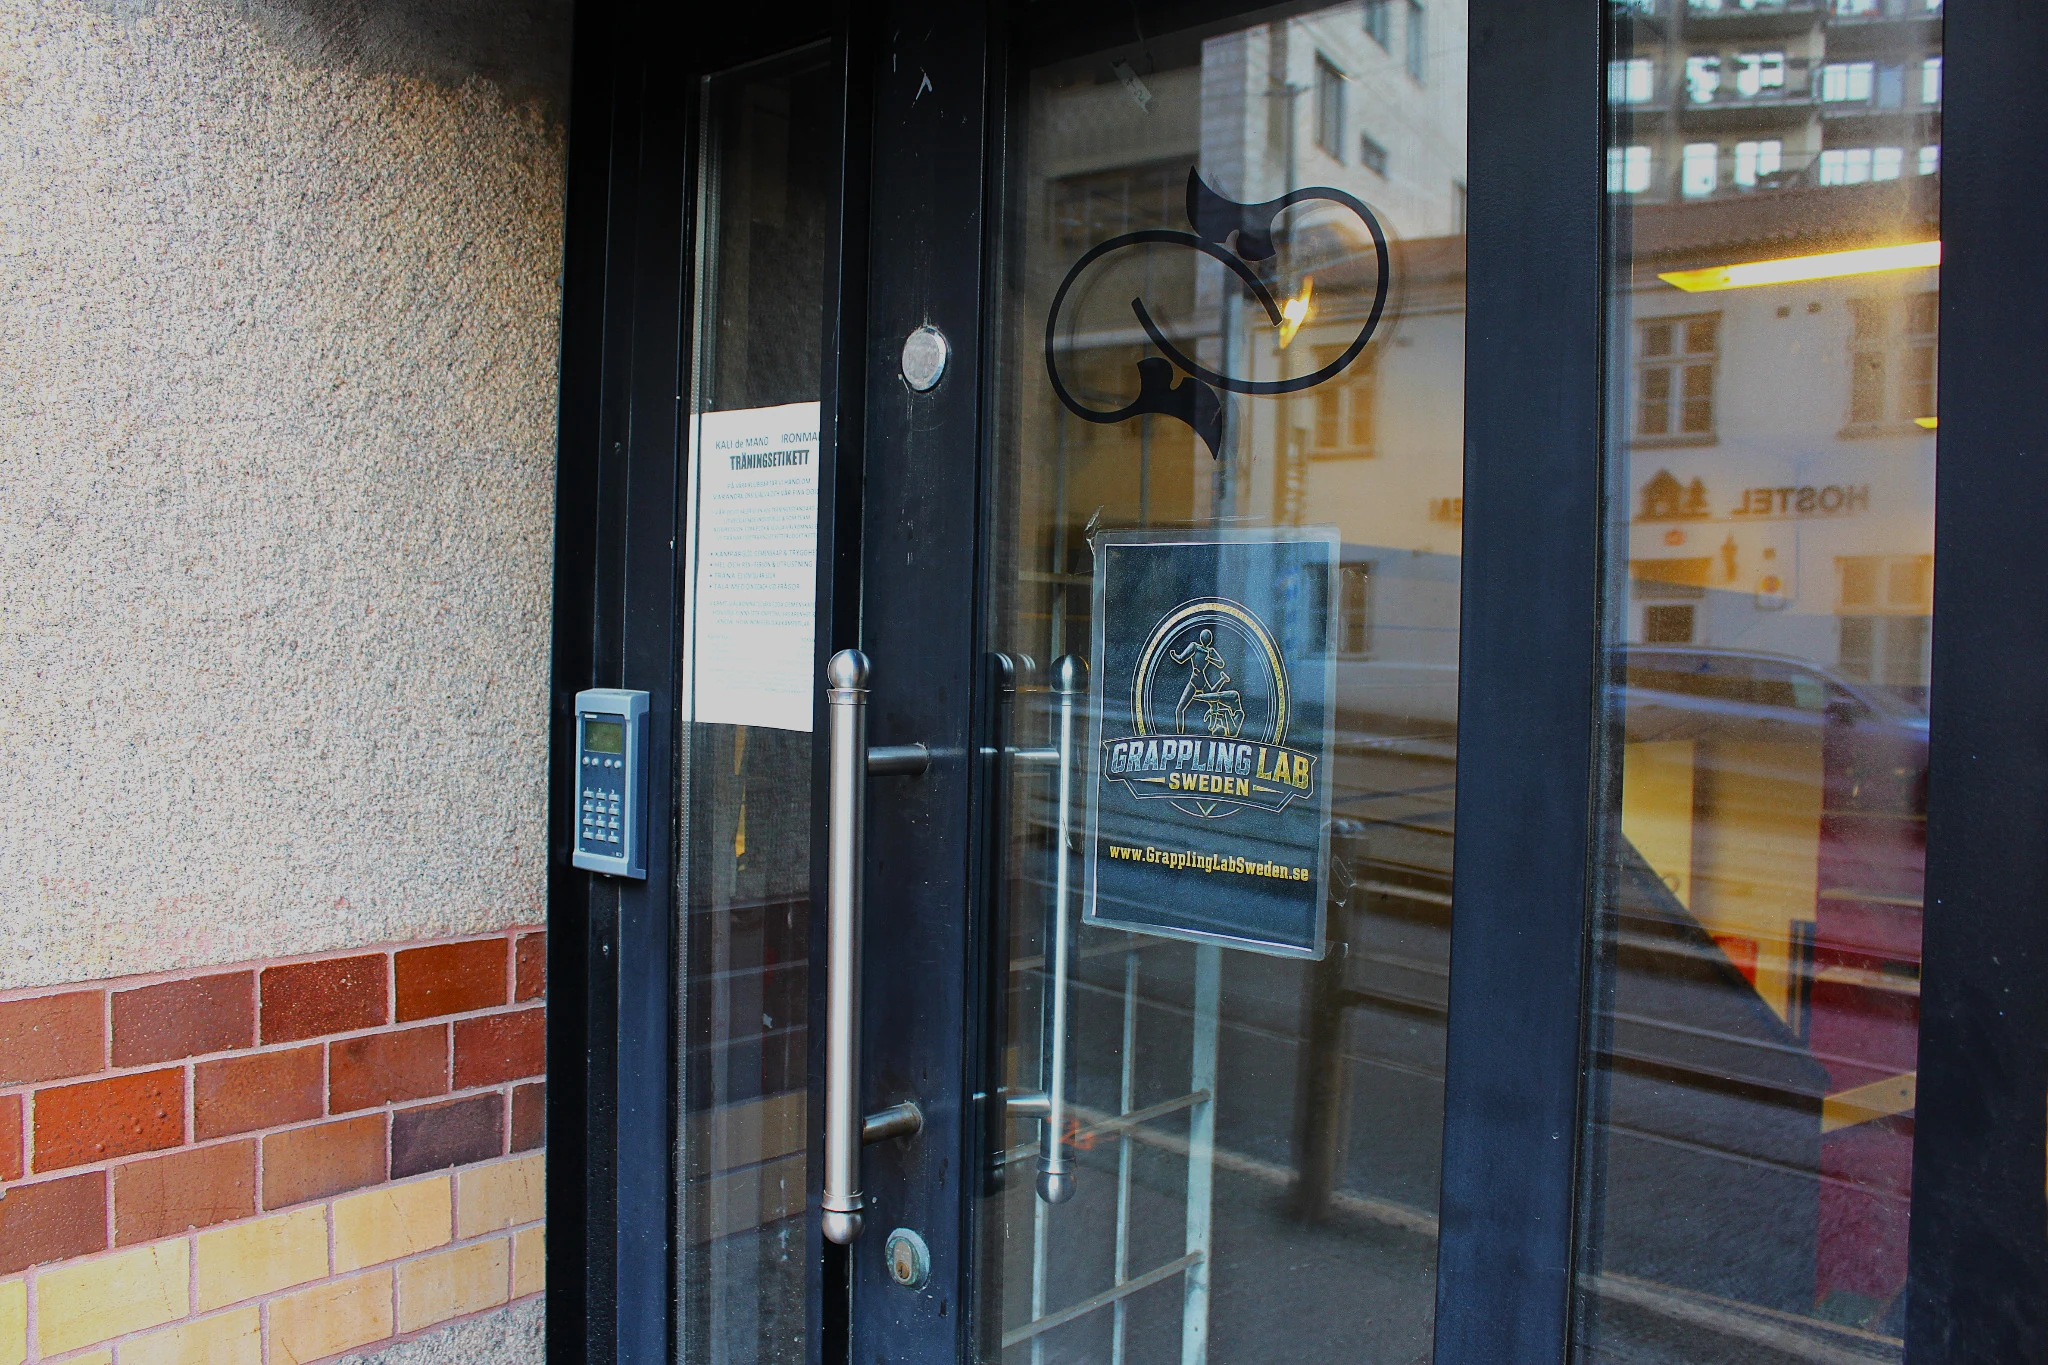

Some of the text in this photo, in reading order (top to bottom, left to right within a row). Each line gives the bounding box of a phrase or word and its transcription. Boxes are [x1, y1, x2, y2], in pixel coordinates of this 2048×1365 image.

[715, 431, 819, 449] KALI de MANO IRONMA
[730, 449, 810, 470] TRÄNINGSETIKETT
[789, 548, 816, 557] TRYGGHE
[1110, 739, 1311, 790] GRAPPLING LAB
[1168, 772, 1250, 797] SWEDEN
[1109, 843, 1310, 883] www.GrapplingLabSweden.se
